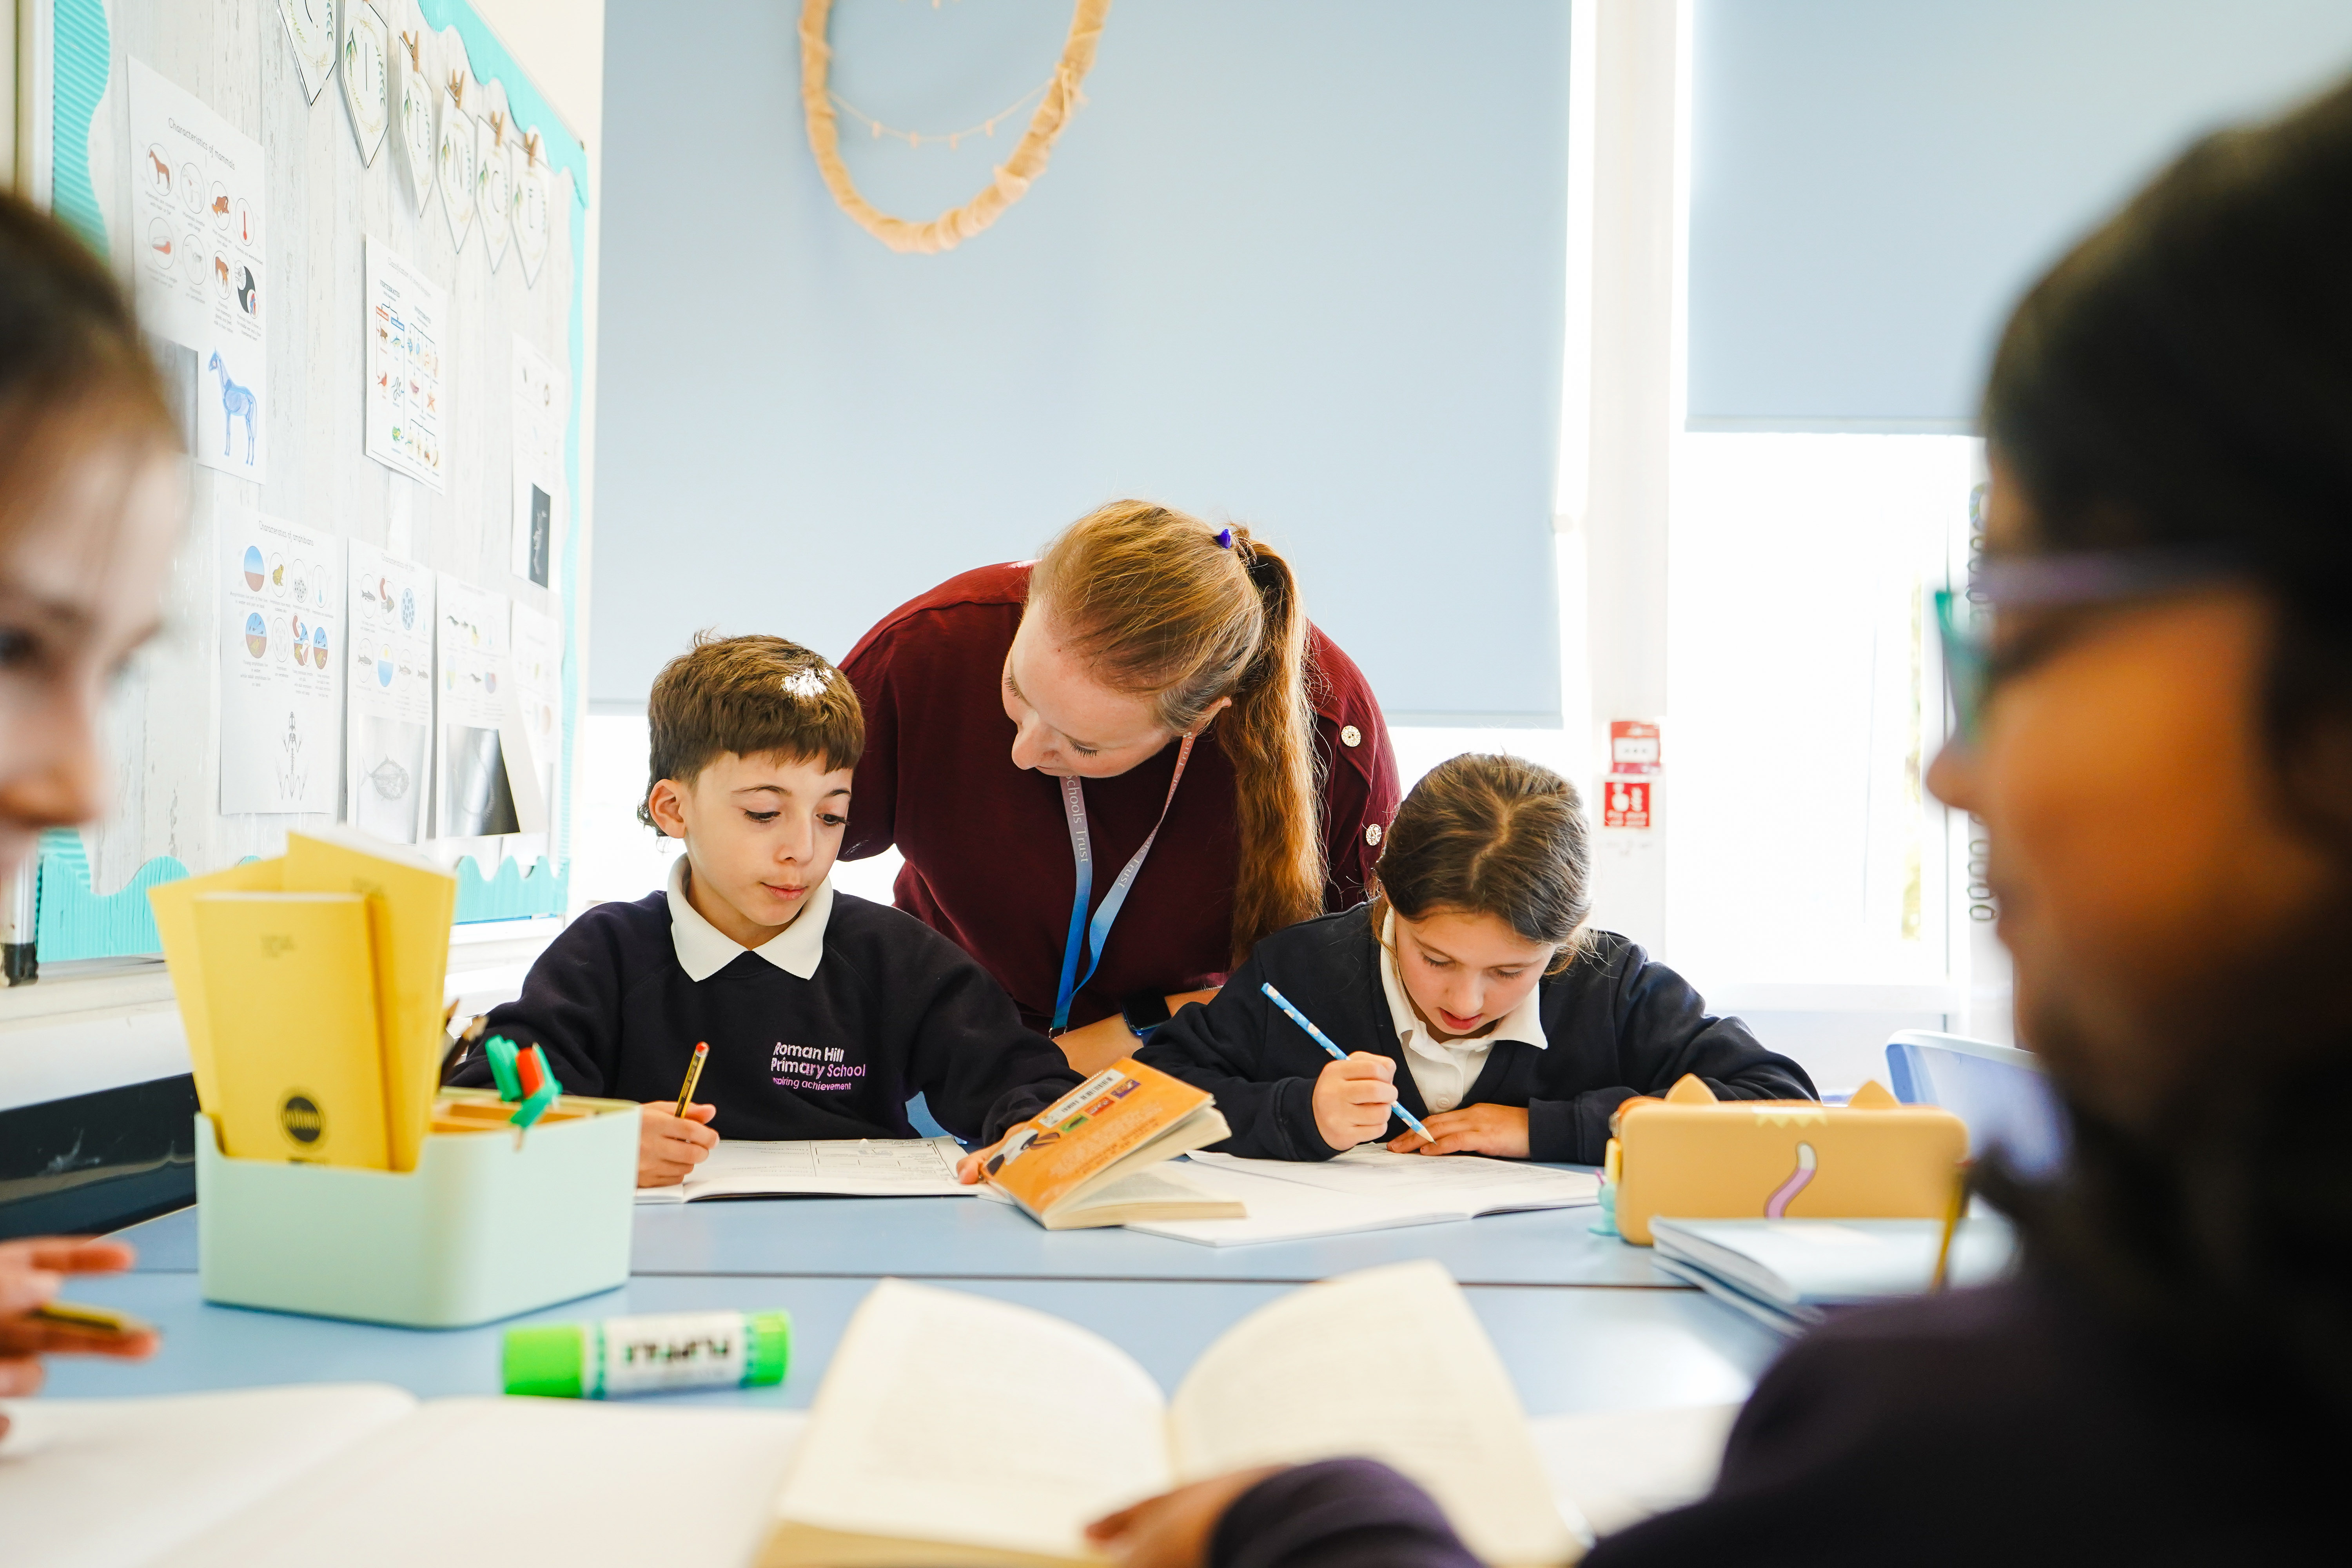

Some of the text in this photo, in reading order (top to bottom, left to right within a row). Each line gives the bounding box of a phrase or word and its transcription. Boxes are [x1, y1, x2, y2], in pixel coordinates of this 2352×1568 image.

[169, 118, 235, 170] Characteristics of mammals
[380, 279, 400, 298] VERTEBRATES
[259, 521, 314, 546] Characteristics of amphibians
[1076, 827, 1089, 862] Trust
[1117, 858, 1142, 889] Trust
[773, 1042, 844, 1063] Roman Hill
[771, 1057, 866, 1080] Primary School
[801, 1080, 852, 1091] achievement
